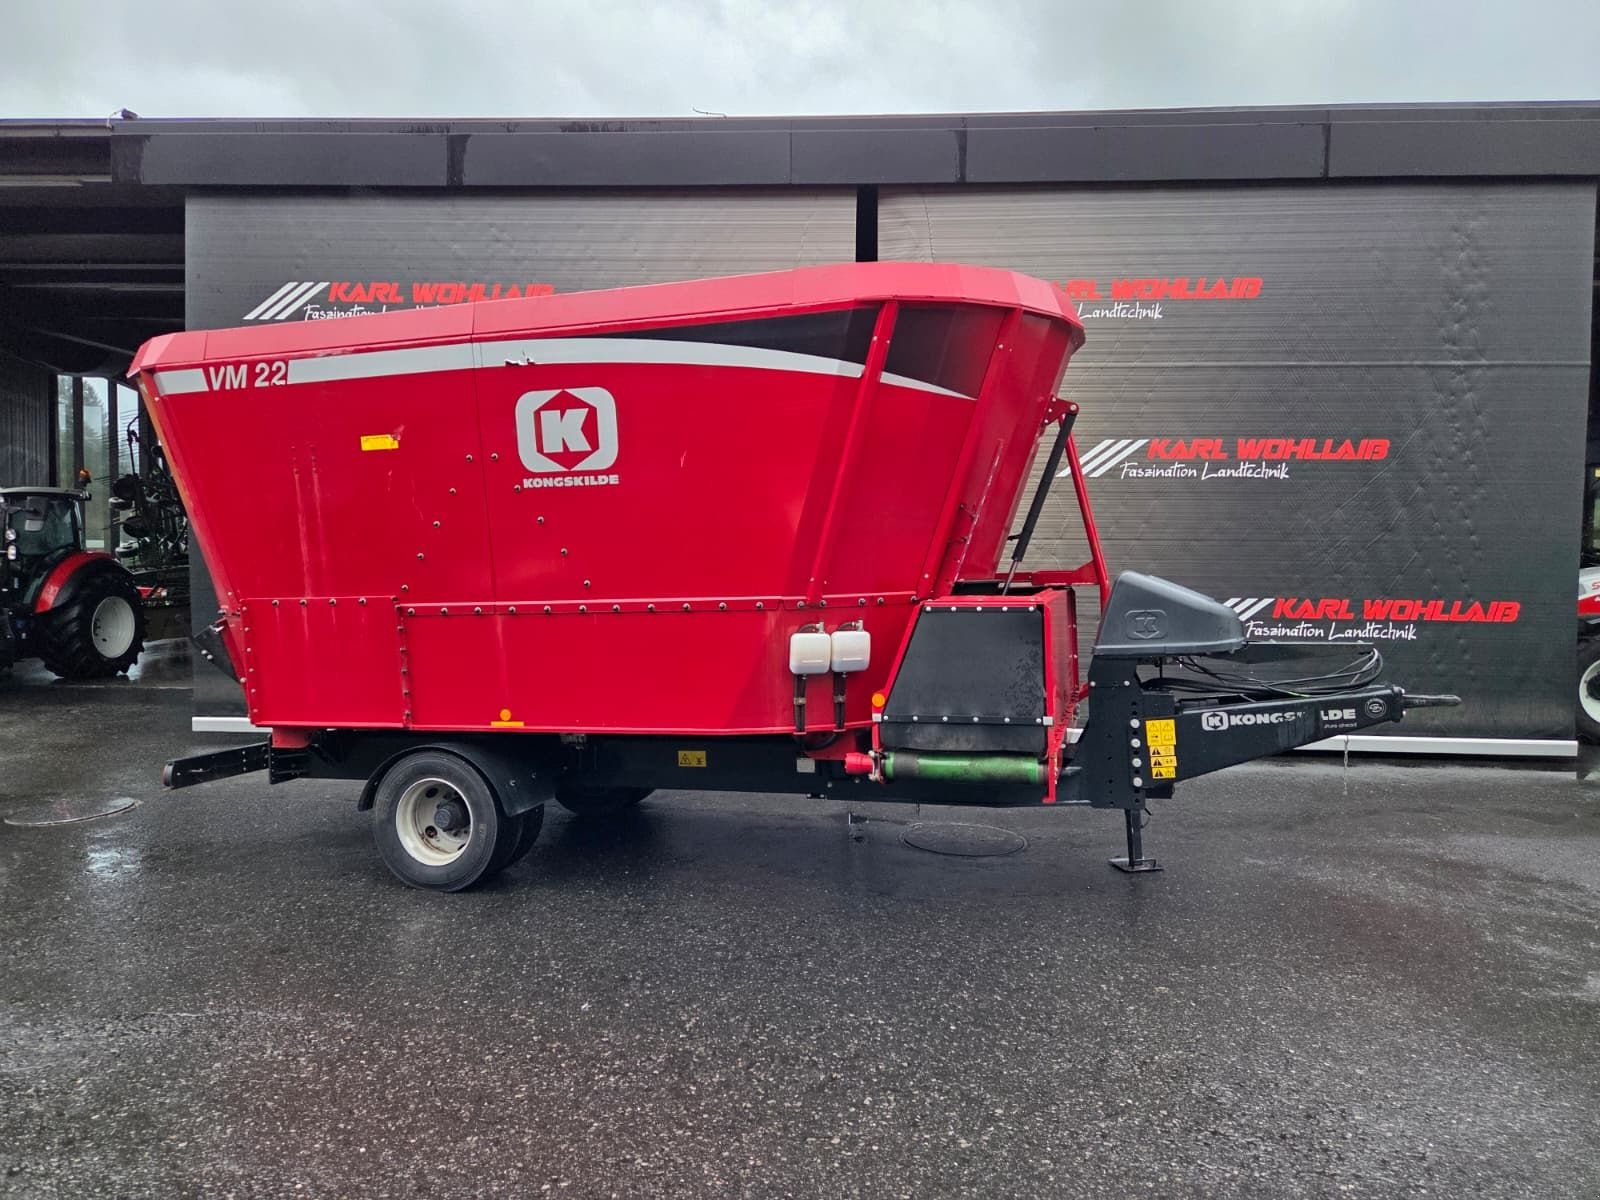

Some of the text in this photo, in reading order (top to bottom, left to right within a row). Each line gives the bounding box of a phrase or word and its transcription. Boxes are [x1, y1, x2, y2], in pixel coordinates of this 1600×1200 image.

[328, 281, 404, 303] KARL
[1050, 278, 1103, 300] RL
[1077, 302, 1163, 319] Landtechnik
[208, 360, 287, 391] VM 22
[1147, 438, 1390, 461] KARL WOHLLAIB
[1119, 461, 1289, 480] Faszination Landtechnik
[523, 475, 619, 489] KONGSKILDE
[1271, 598, 1521, 623] KARL WOHLLAIB
[1245, 620, 1417, 640] Faszination Landtechnik
